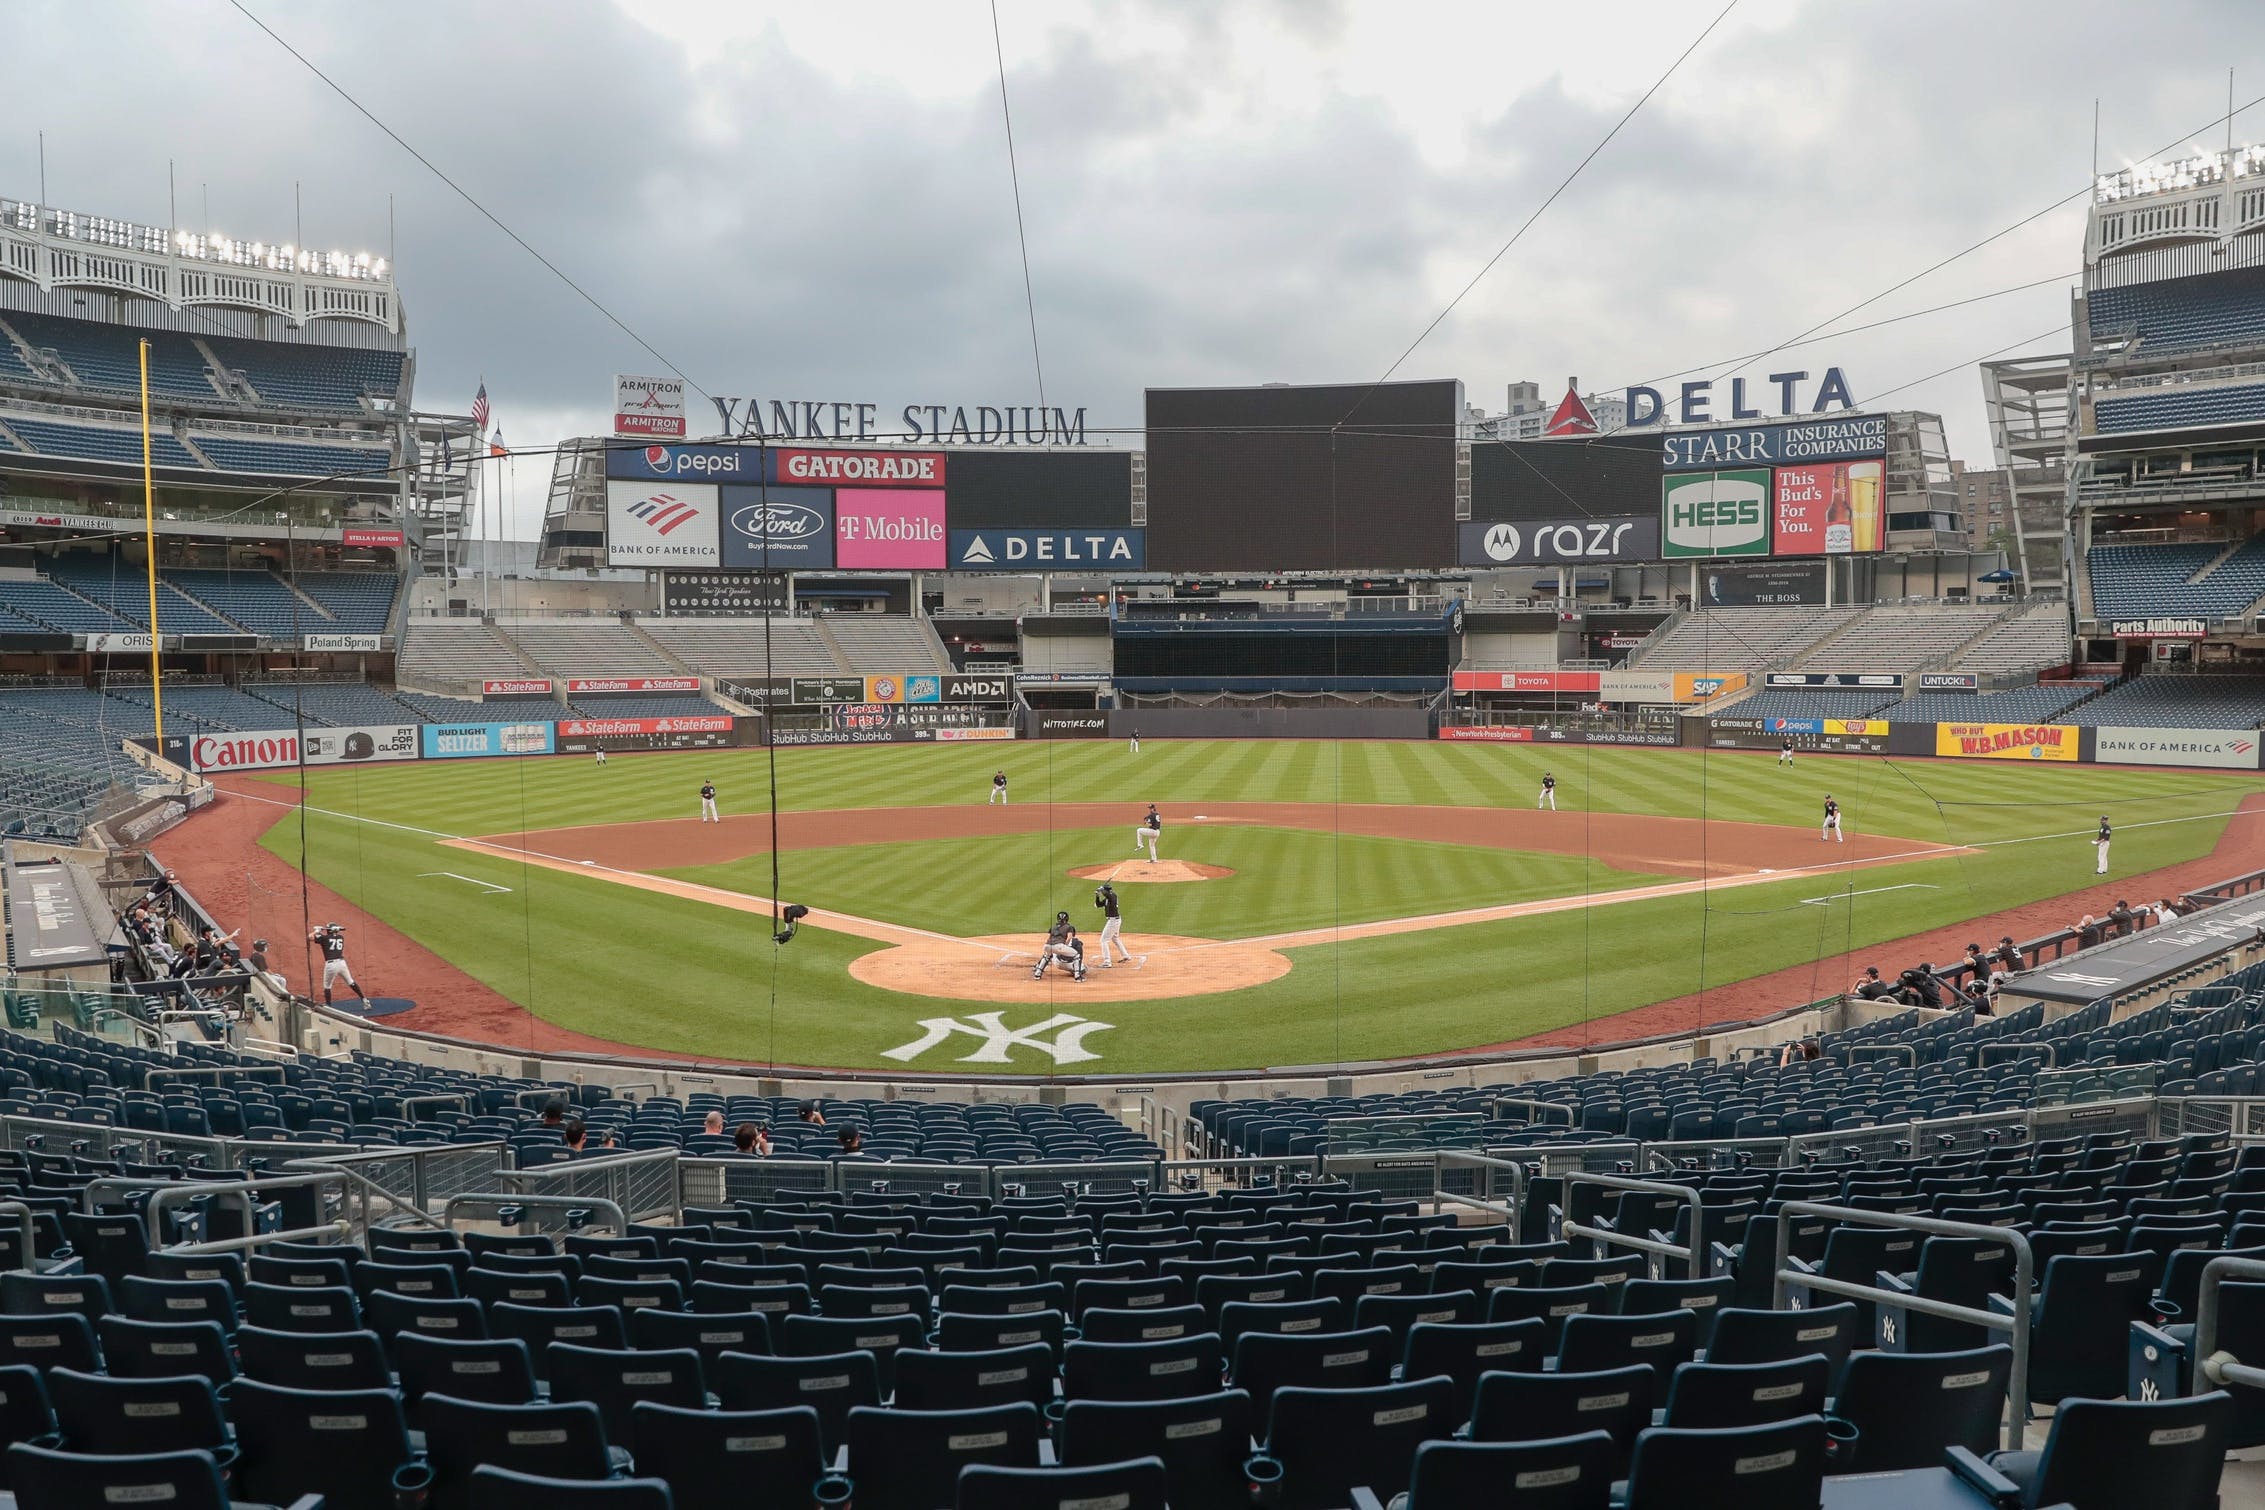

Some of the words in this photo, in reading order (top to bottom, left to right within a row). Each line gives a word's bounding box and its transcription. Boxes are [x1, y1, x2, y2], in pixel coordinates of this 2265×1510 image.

[620, 380, 681, 393] ARMITRON
[1626, 366, 1857, 428] DELTA
[624, 416, 679, 428] ARMITRON
[711, 396, 878, 441] YANKEE
[902, 404, 1088, 446] STADIUM
[1662, 431, 1773, 466] STARR
[1786, 419, 1886, 442] INSURANCE
[1785, 435, 1886, 457] COMPANIES
[677, 452, 740, 475] pepsi
[788, 456, 935, 480] GATORADE
[1780, 471, 1815, 486] This
[1780, 486, 1822, 502] Bud's
[1673, 499, 1759, 528] HESS
[1780, 504, 1806, 518] For
[36, 516, 61, 526] Audi
[64, 517, 98, 528] YANKEES
[747, 507, 808, 534] Ford
[1779, 519, 1813, 533] You.
[1534, 523, 1633, 557] razr
[611, 545, 643, 554] BANK
[646, 545, 661, 555] OF
[664, 546, 716, 556] AMERICA
[1006, 536, 1132, 560] DELTA
[1756, 595, 1774, 603] THE
[1777, 594, 1800, 602] BOSS
[2112, 620, 2145, 633] Parts
[2147, 617, 2206, 633] Authority
[122, 635, 153, 646] ORIS
[310, 636, 343, 649] Poland
[344, 636, 376, 650] Spring
[950, 682, 990, 696] AMD
[1694, 681, 1718, 694] SAP
[398, 728, 413, 736] FIT
[438, 728, 458, 736] BUD
[460, 728, 487, 736] LIGHT
[1788, 721, 1813, 731] pepsi
[1950, 727, 1967, 735] WHO
[392, 736, 413, 744] FOR
[773, 734, 807, 744] StubHub
[810, 733, 849, 743] StubHub
[852, 731, 892, 742] StubHub
[915, 730, 927, 738] 399
[1550, 731, 1562, 739] 385
[1586, 733, 1616, 742] StubHub
[1617, 734, 1646, 743] StubHub
[1647, 735, 1675, 744] StubHub
[378, 743, 413, 752] GLORY
[437, 735, 488, 753] SELTZER
[2101, 741, 2136, 750] BANK
[2139, 742, 2155, 751] OF
[2160, 743, 2222, 753] AMERICA
[192, 737, 298, 768] Canon
[329, 938, 344, 951] 76
